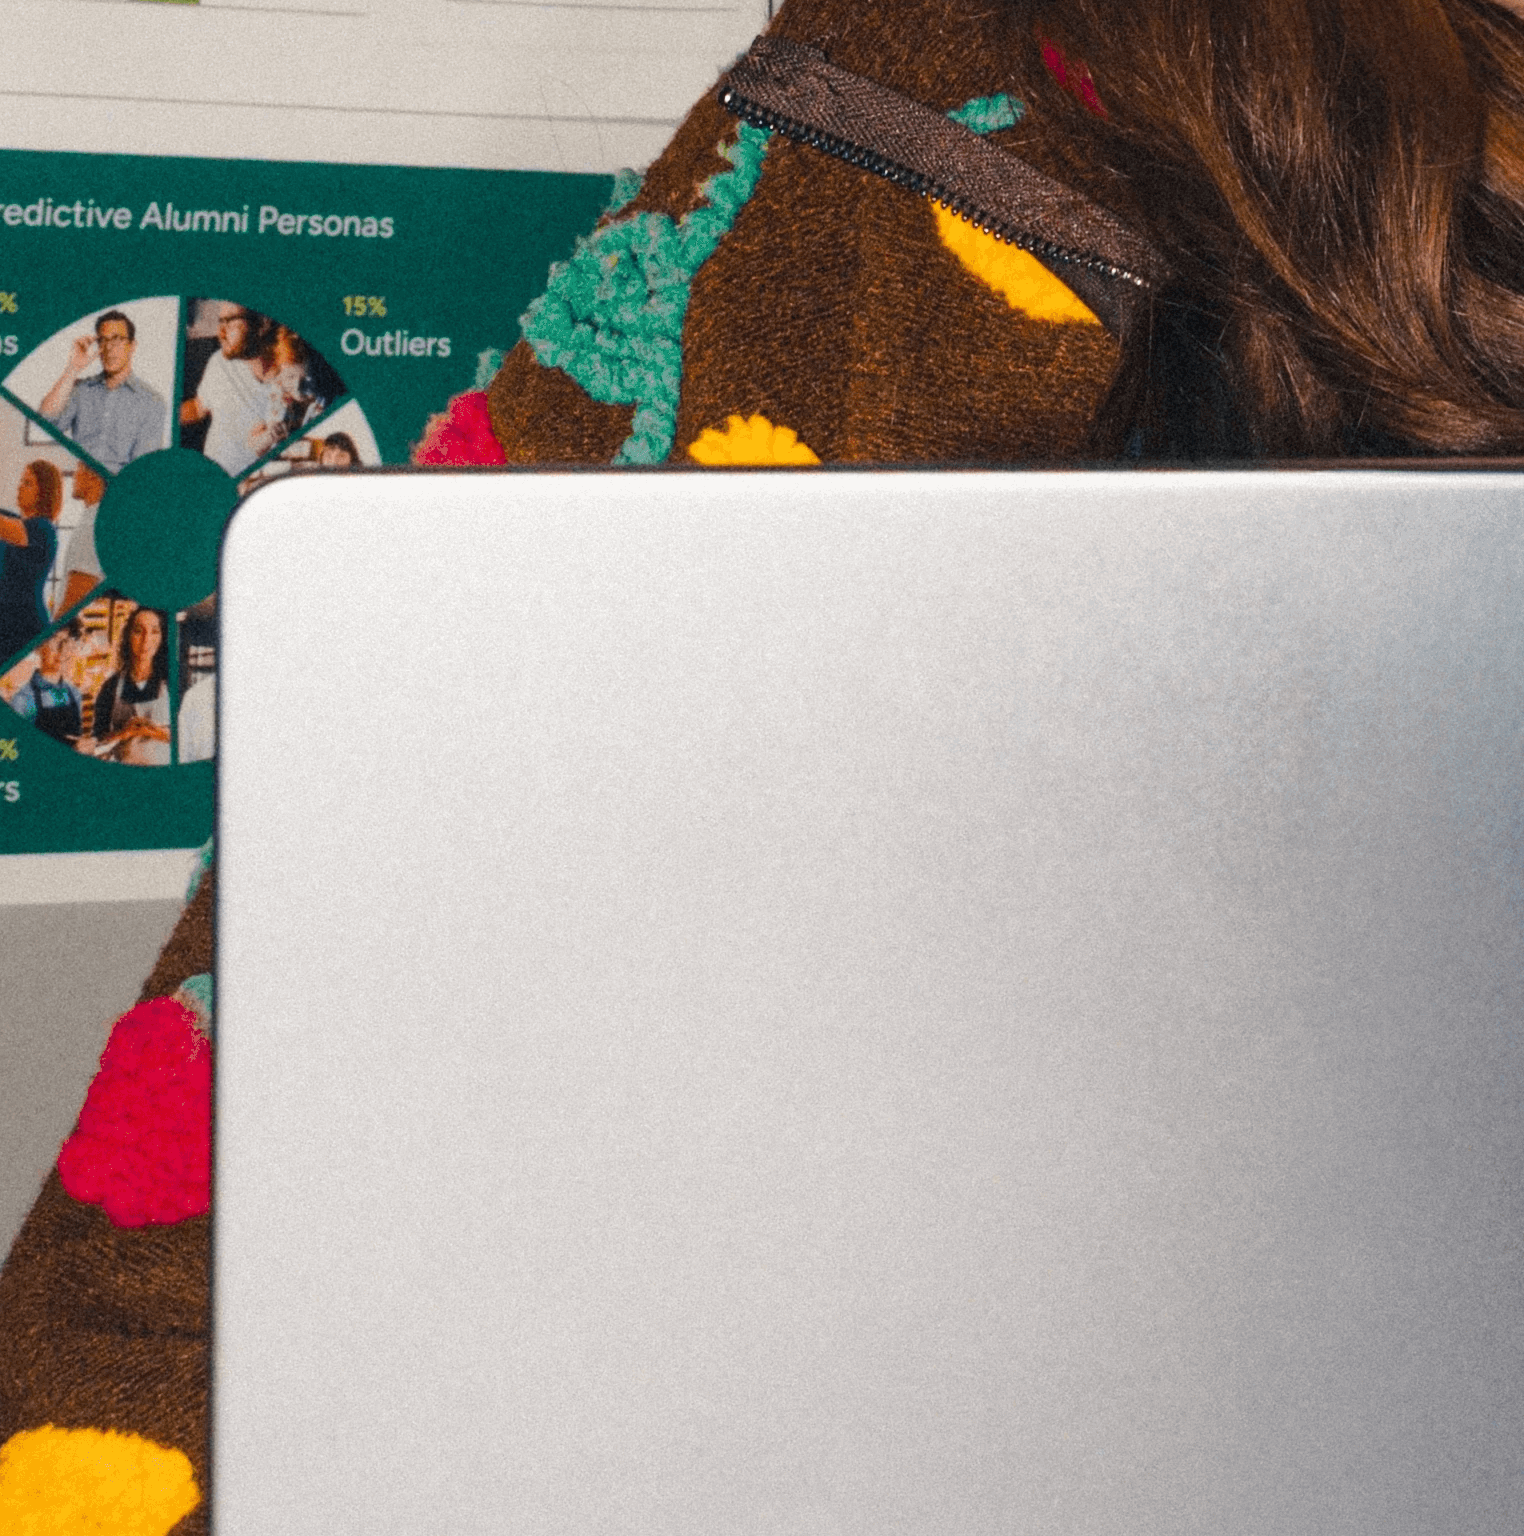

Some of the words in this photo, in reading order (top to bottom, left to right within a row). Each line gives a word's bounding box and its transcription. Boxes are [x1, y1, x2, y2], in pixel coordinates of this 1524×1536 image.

[139, 201, 249, 233] Alumni
[258, 205, 395, 239] Personas
[342, 295, 387, 318] 15%
[340, 328, 452, 358] Outliers
